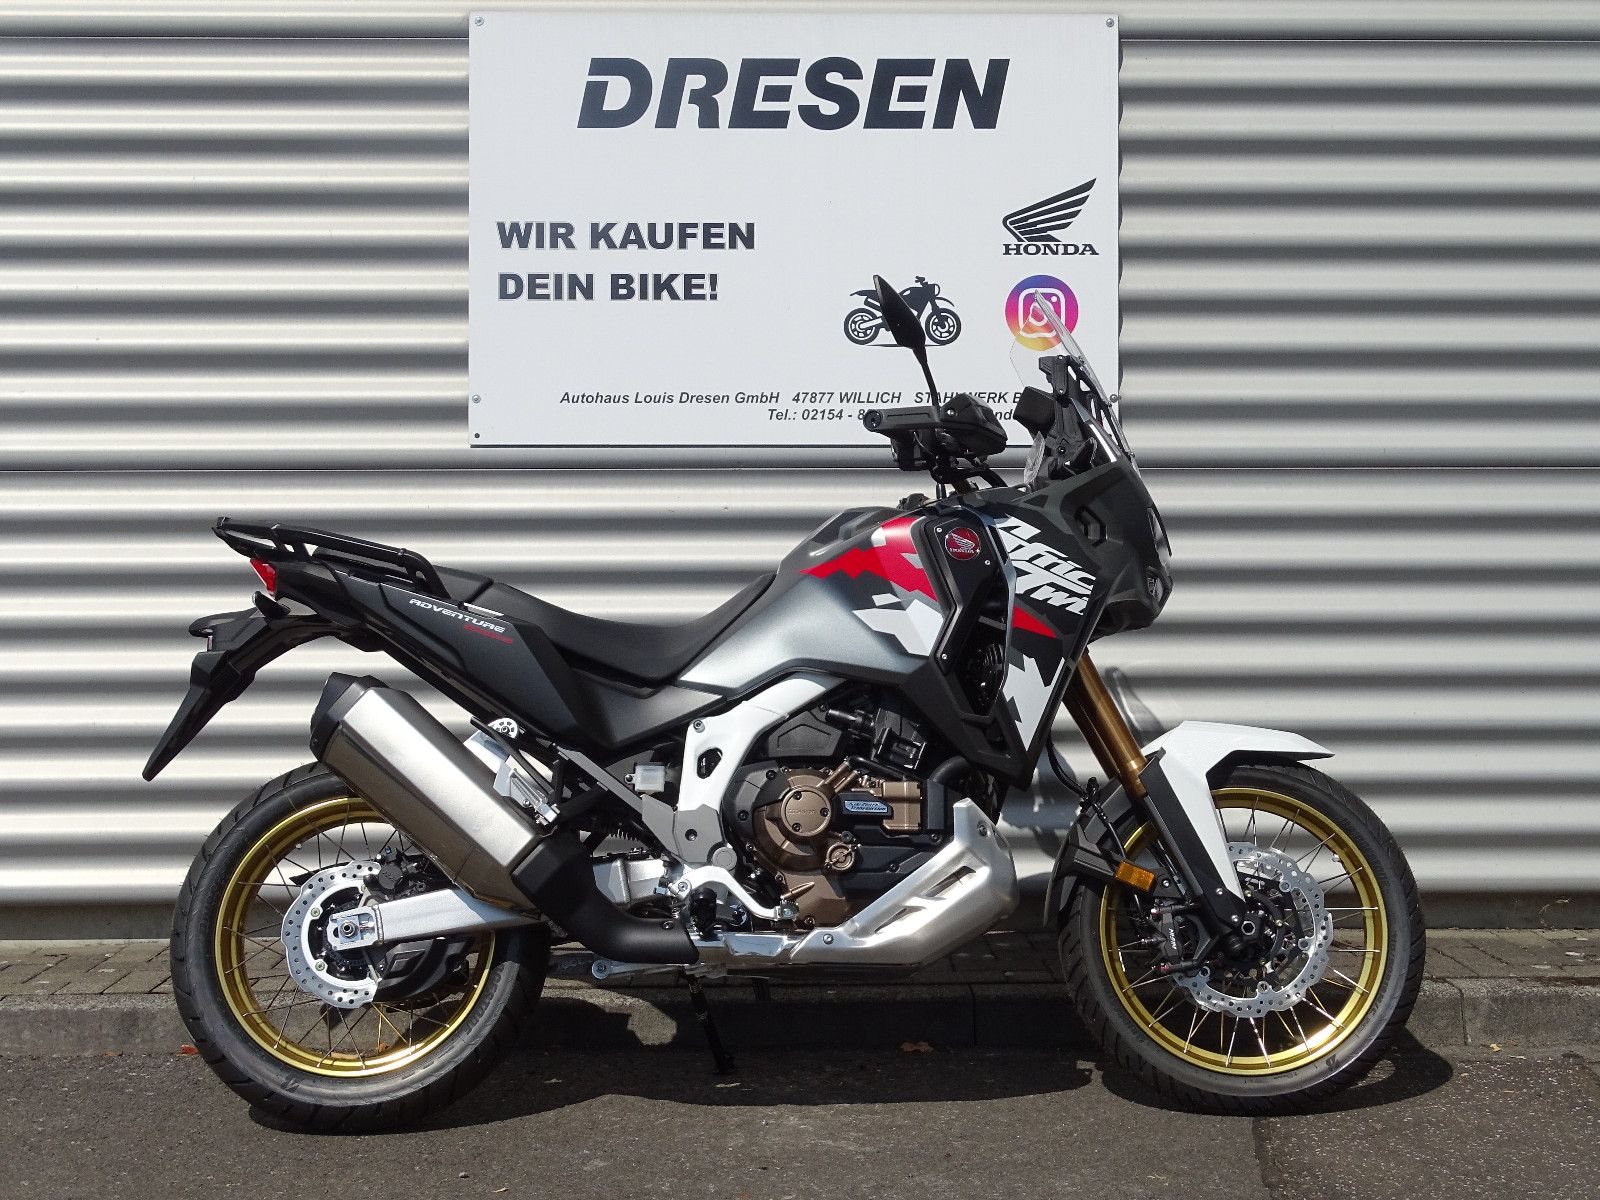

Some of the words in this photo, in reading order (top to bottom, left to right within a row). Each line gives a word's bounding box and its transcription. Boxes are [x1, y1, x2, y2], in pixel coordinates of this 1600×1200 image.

[577, 57, 1010, 130] DRESEN
[497, 222, 575, 249] WIR
[591, 222, 755, 250] KAUFEN
[1002, 243, 1099, 256] HONDA
[499, 273, 594, 301] DEIN
[611, 273, 718, 301] BIKE!
[560, 391, 630, 404] Autohaus
[634, 391, 675, 404] Louis
[679, 391, 730, 404] Dresen
[735, 391, 780, 404] GmbH
[792, 391, 835, 404] 47877
[839, 391, 902, 404] WILLICH
[768, 409, 797, 421] Tel.:
[801, 409, 844, 421] 02154
[408, 598, 506, 633] ADVENTURE
